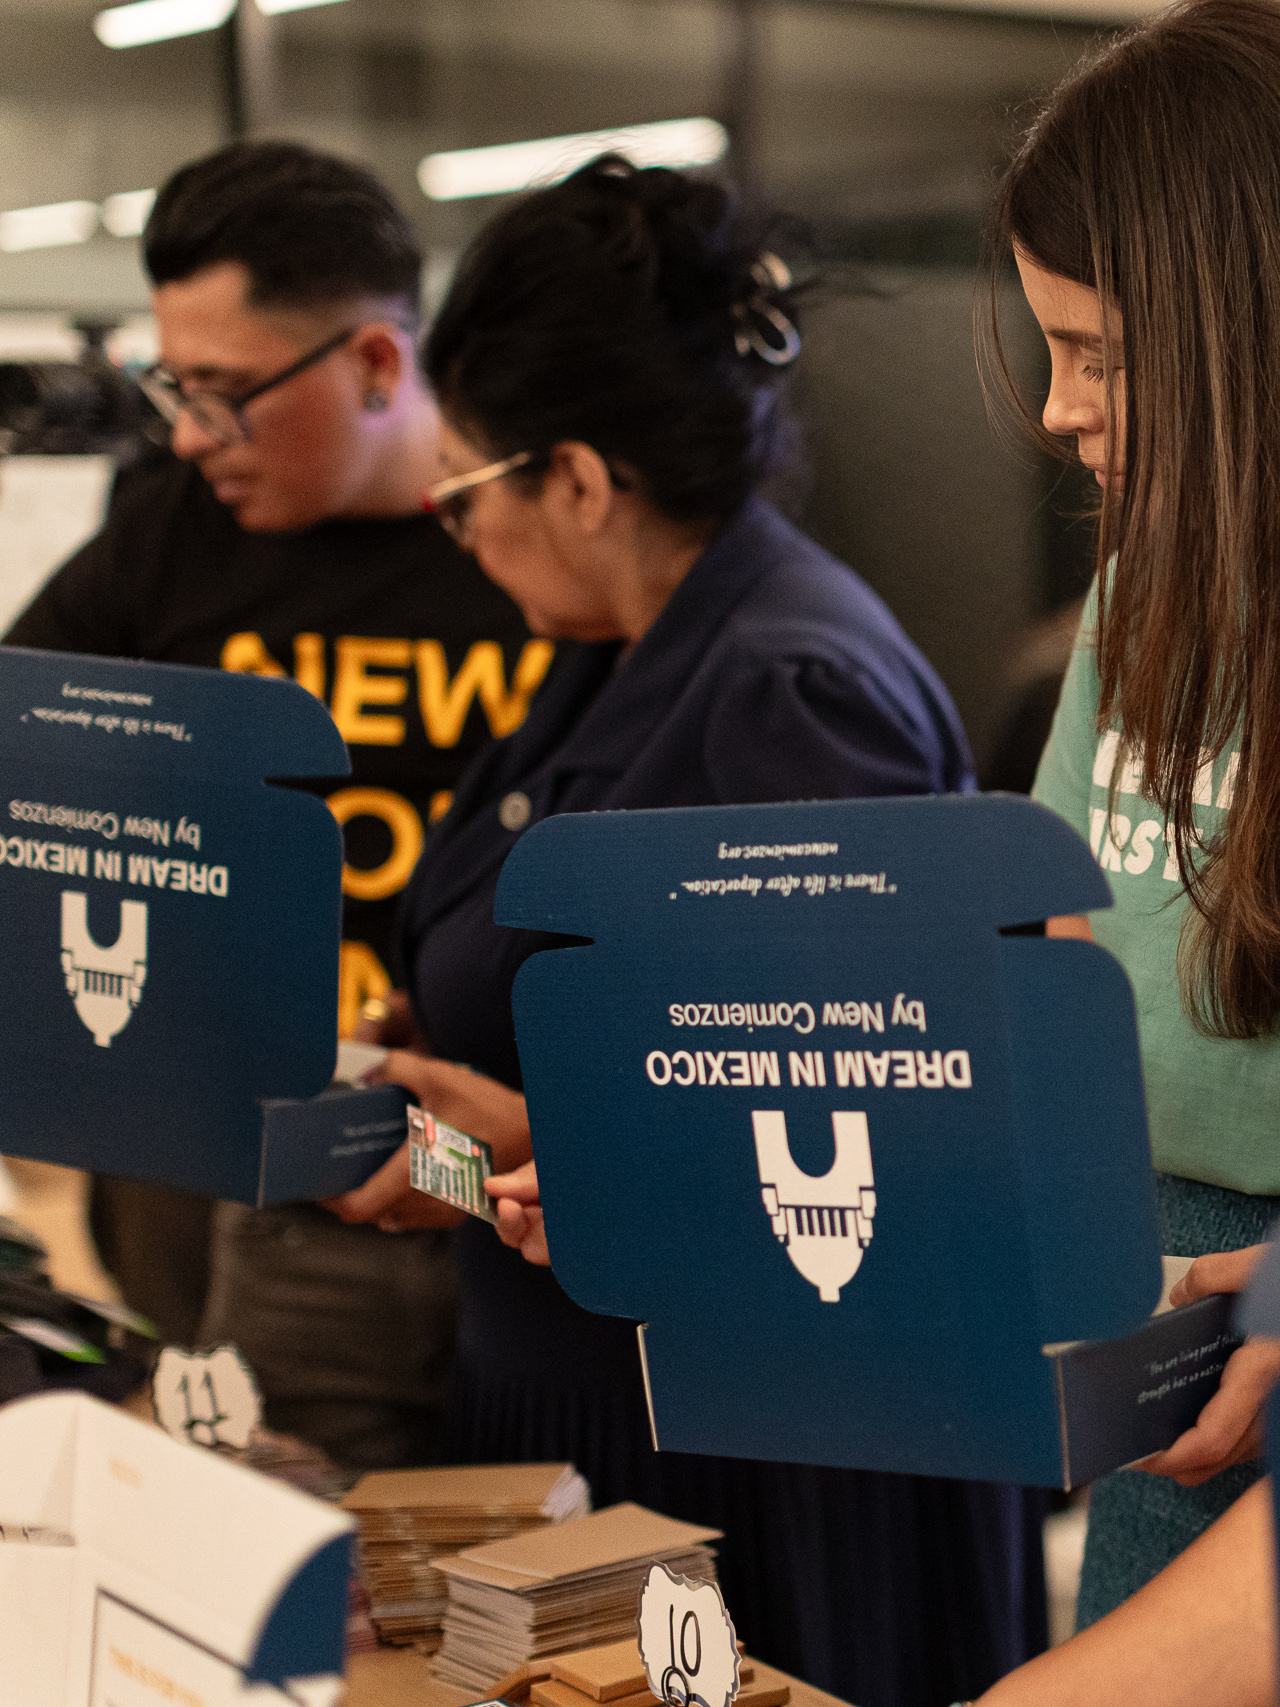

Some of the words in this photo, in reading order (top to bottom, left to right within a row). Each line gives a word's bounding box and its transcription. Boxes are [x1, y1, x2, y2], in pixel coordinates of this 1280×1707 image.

[8, 799, 119, 841] Comienzos
[123, 815, 170, 847] New
[174, 815, 201, 851] by
[717, 842, 838, 861] newcomienzos.org
[1089, 806, 1204, 882] IRST
[94, 849, 122, 882] IN
[128, 853, 229, 897] DREAM
[829, 873, 842, 891] is
[765, 873, 801, 897] after
[804, 873, 826, 896] life
[668, 1001, 816, 1034] Comienzos
[822, 1001, 885, 1033] New
[891, 992, 927, 1033] by
[646, 1050, 781, 1087] MEXICO
[788, 1051, 826, 1087] IN
[834, 1050, 973, 1089] DREAM
[669, 1603, 702, 1677] 10
